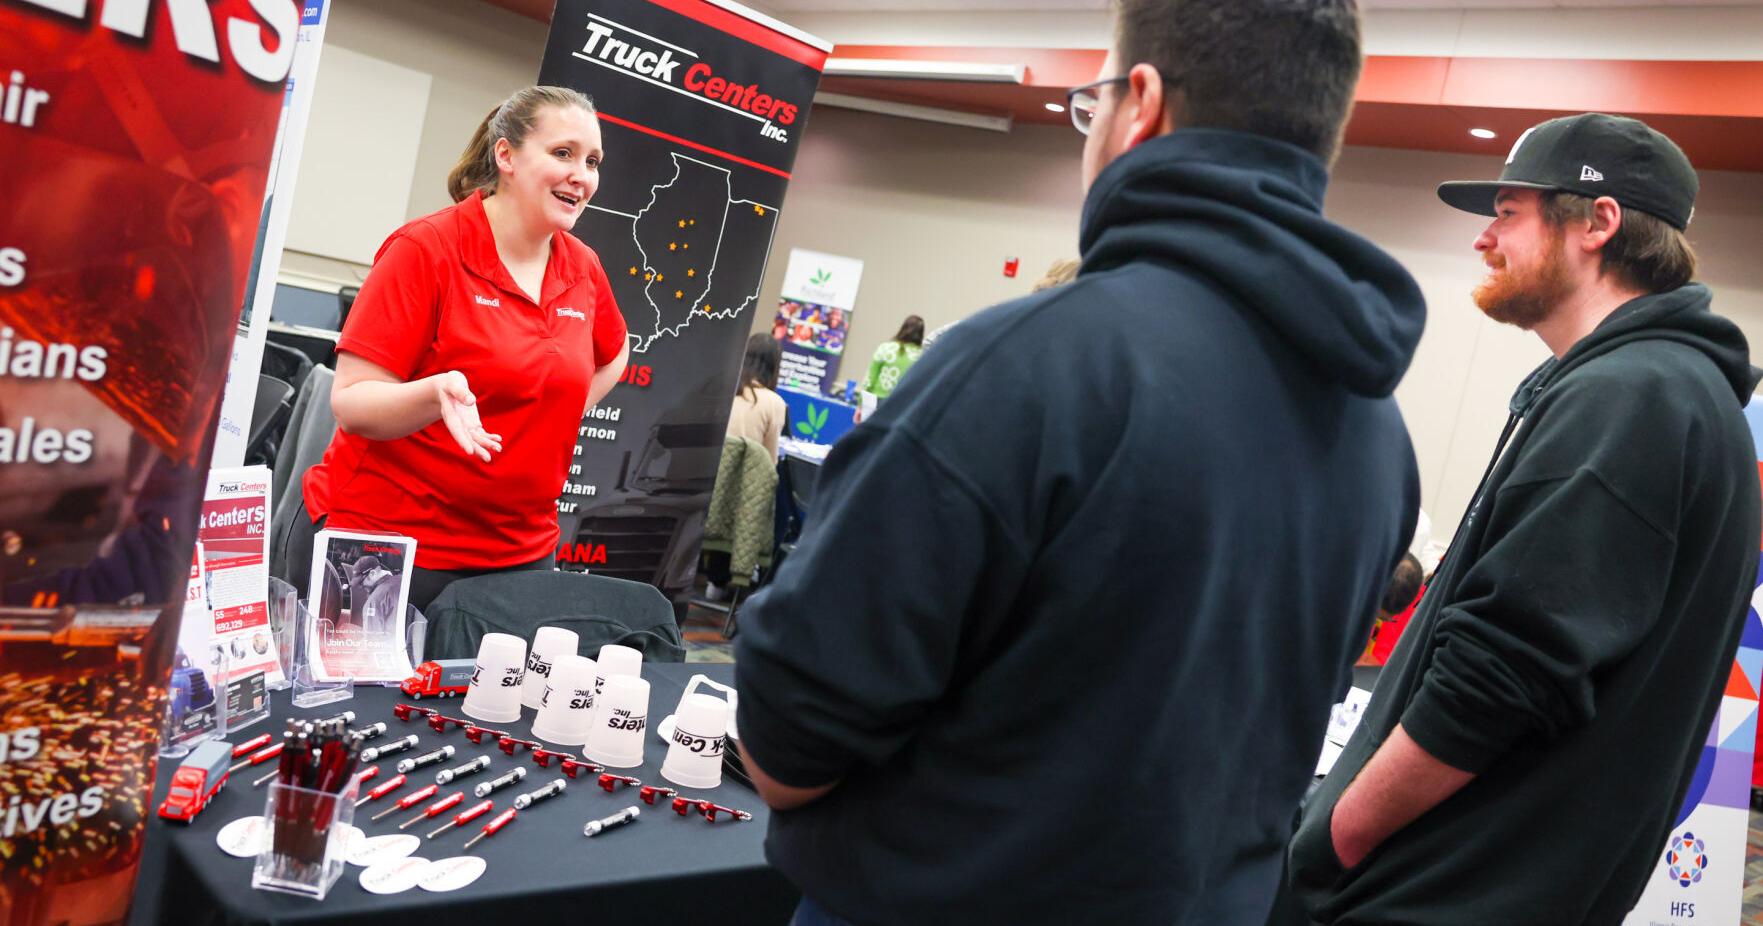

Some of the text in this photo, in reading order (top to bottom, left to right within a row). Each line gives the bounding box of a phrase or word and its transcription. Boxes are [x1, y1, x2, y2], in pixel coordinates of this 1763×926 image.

[581, 21, 799, 125] Truck Centers
[760, 119, 788, 143] Inc.
[578, 426, 616, 441] rnon
[219, 482, 266, 492] Truck Centers
[562, 480, 597, 496] ham
[209, 504, 265, 528] Centers
[246, 523, 265, 534] INC.
[556, 542, 607, 564] ANA
[326, 638, 344, 647] Join
[506, 666, 521, 674] Inc.
[574, 688, 591, 697] Inc.
[613, 706, 630, 718] Inc.
[0, 786, 104, 838] ives
[1670, 901, 1695, 918] HFS
